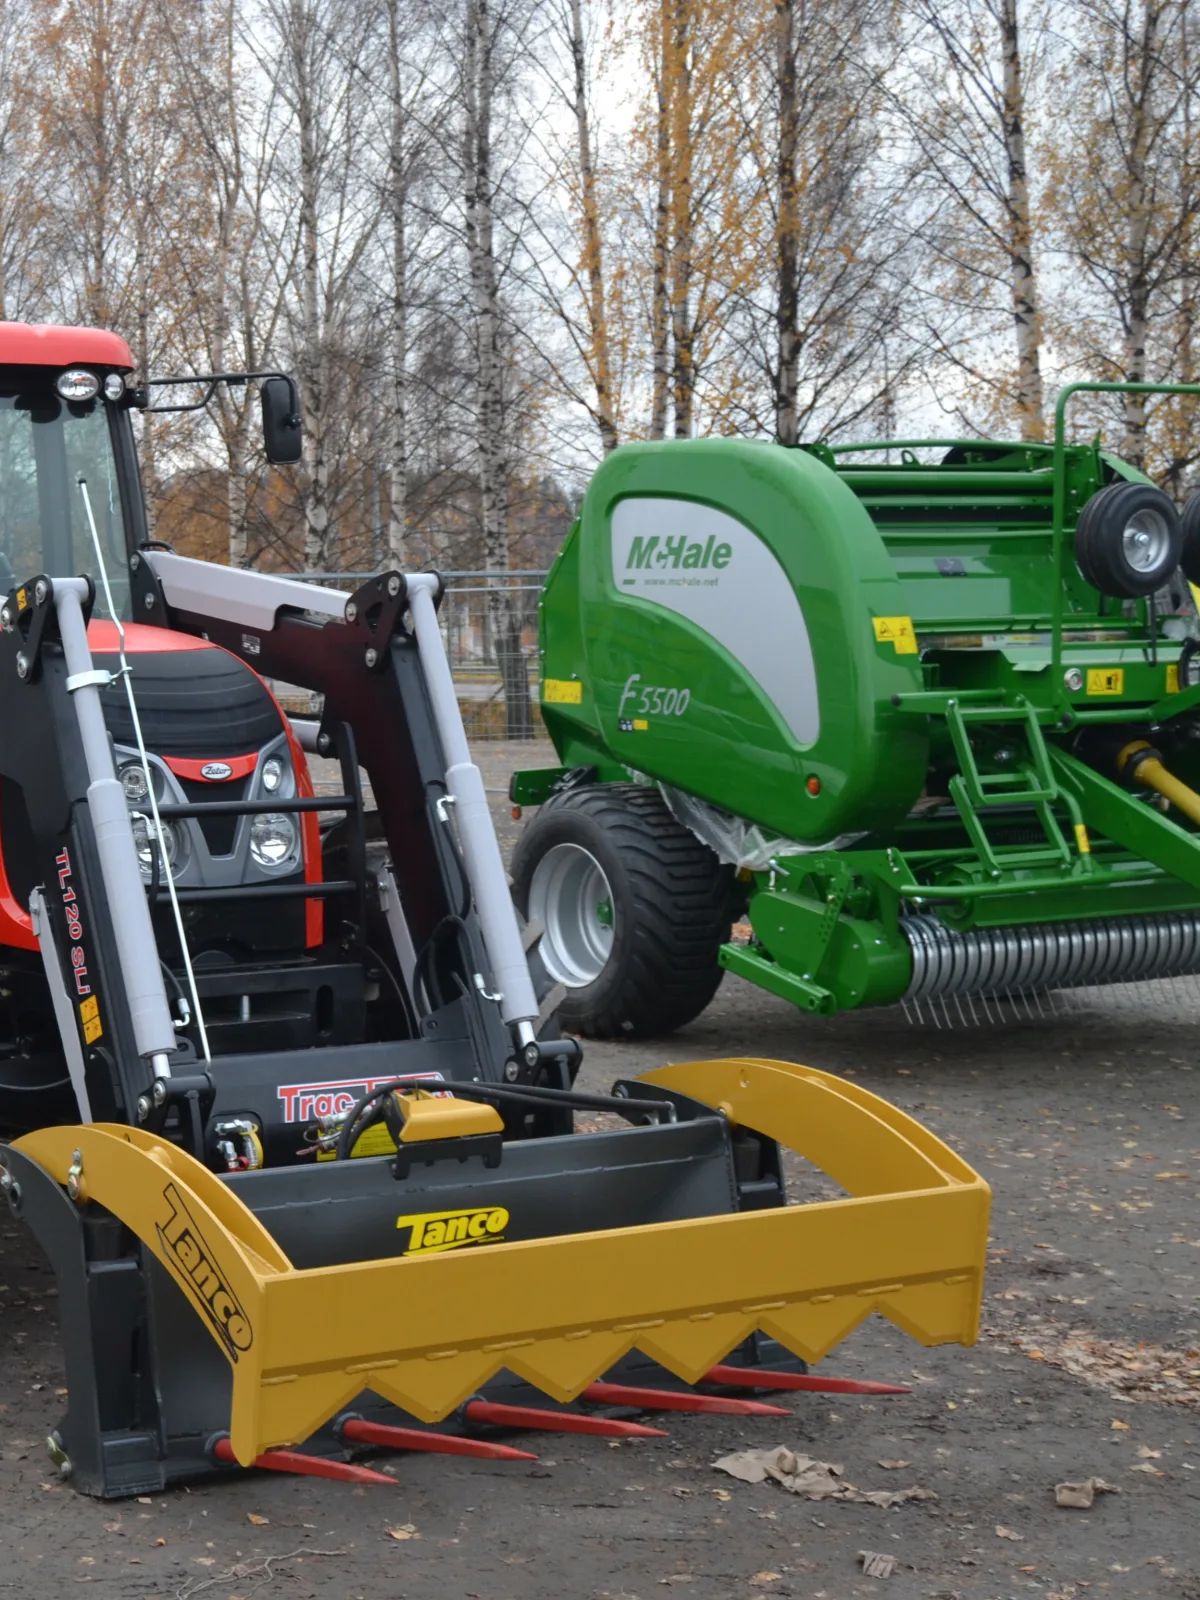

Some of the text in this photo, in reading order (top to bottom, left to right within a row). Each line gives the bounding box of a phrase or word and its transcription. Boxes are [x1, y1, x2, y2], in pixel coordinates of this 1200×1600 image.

[625, 534, 733, 570] McHale
[396, 1206, 510, 1252] Tanco
[162, 1181, 254, 1352] Tanco
